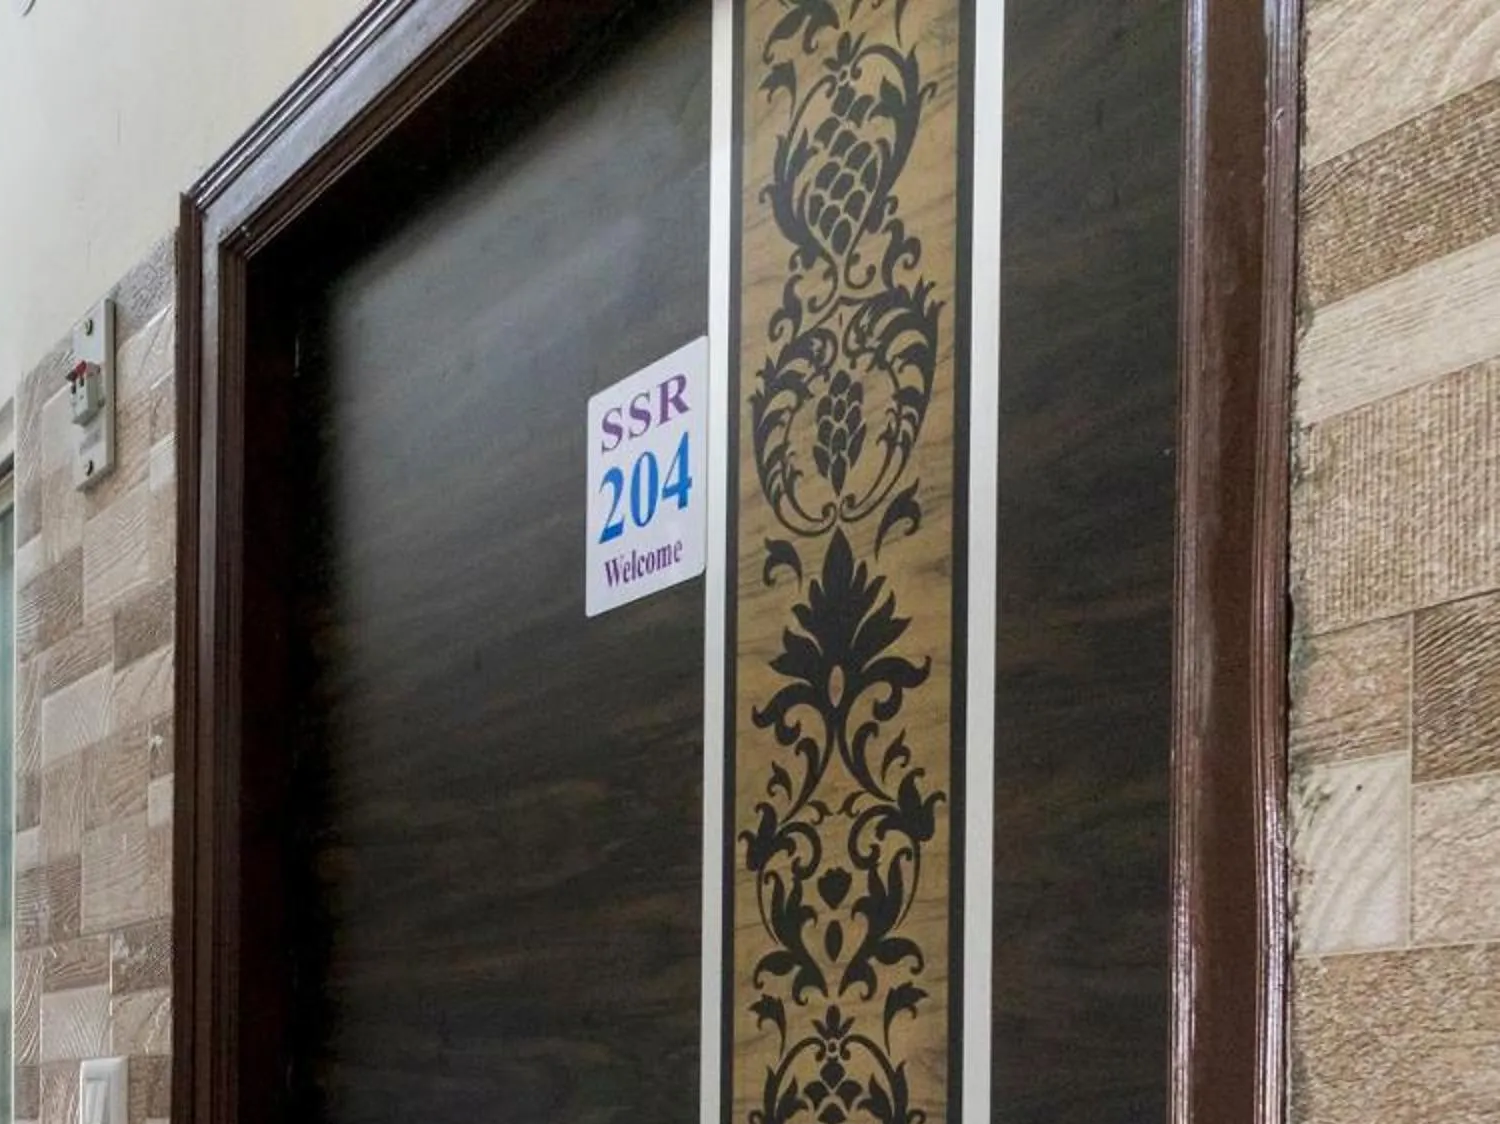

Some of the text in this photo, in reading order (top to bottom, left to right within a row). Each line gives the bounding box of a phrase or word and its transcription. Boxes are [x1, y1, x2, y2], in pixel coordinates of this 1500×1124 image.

[601, 373, 690, 453] SSR
[598, 431, 692, 544] 204
[604, 539, 683, 588] Welcome
